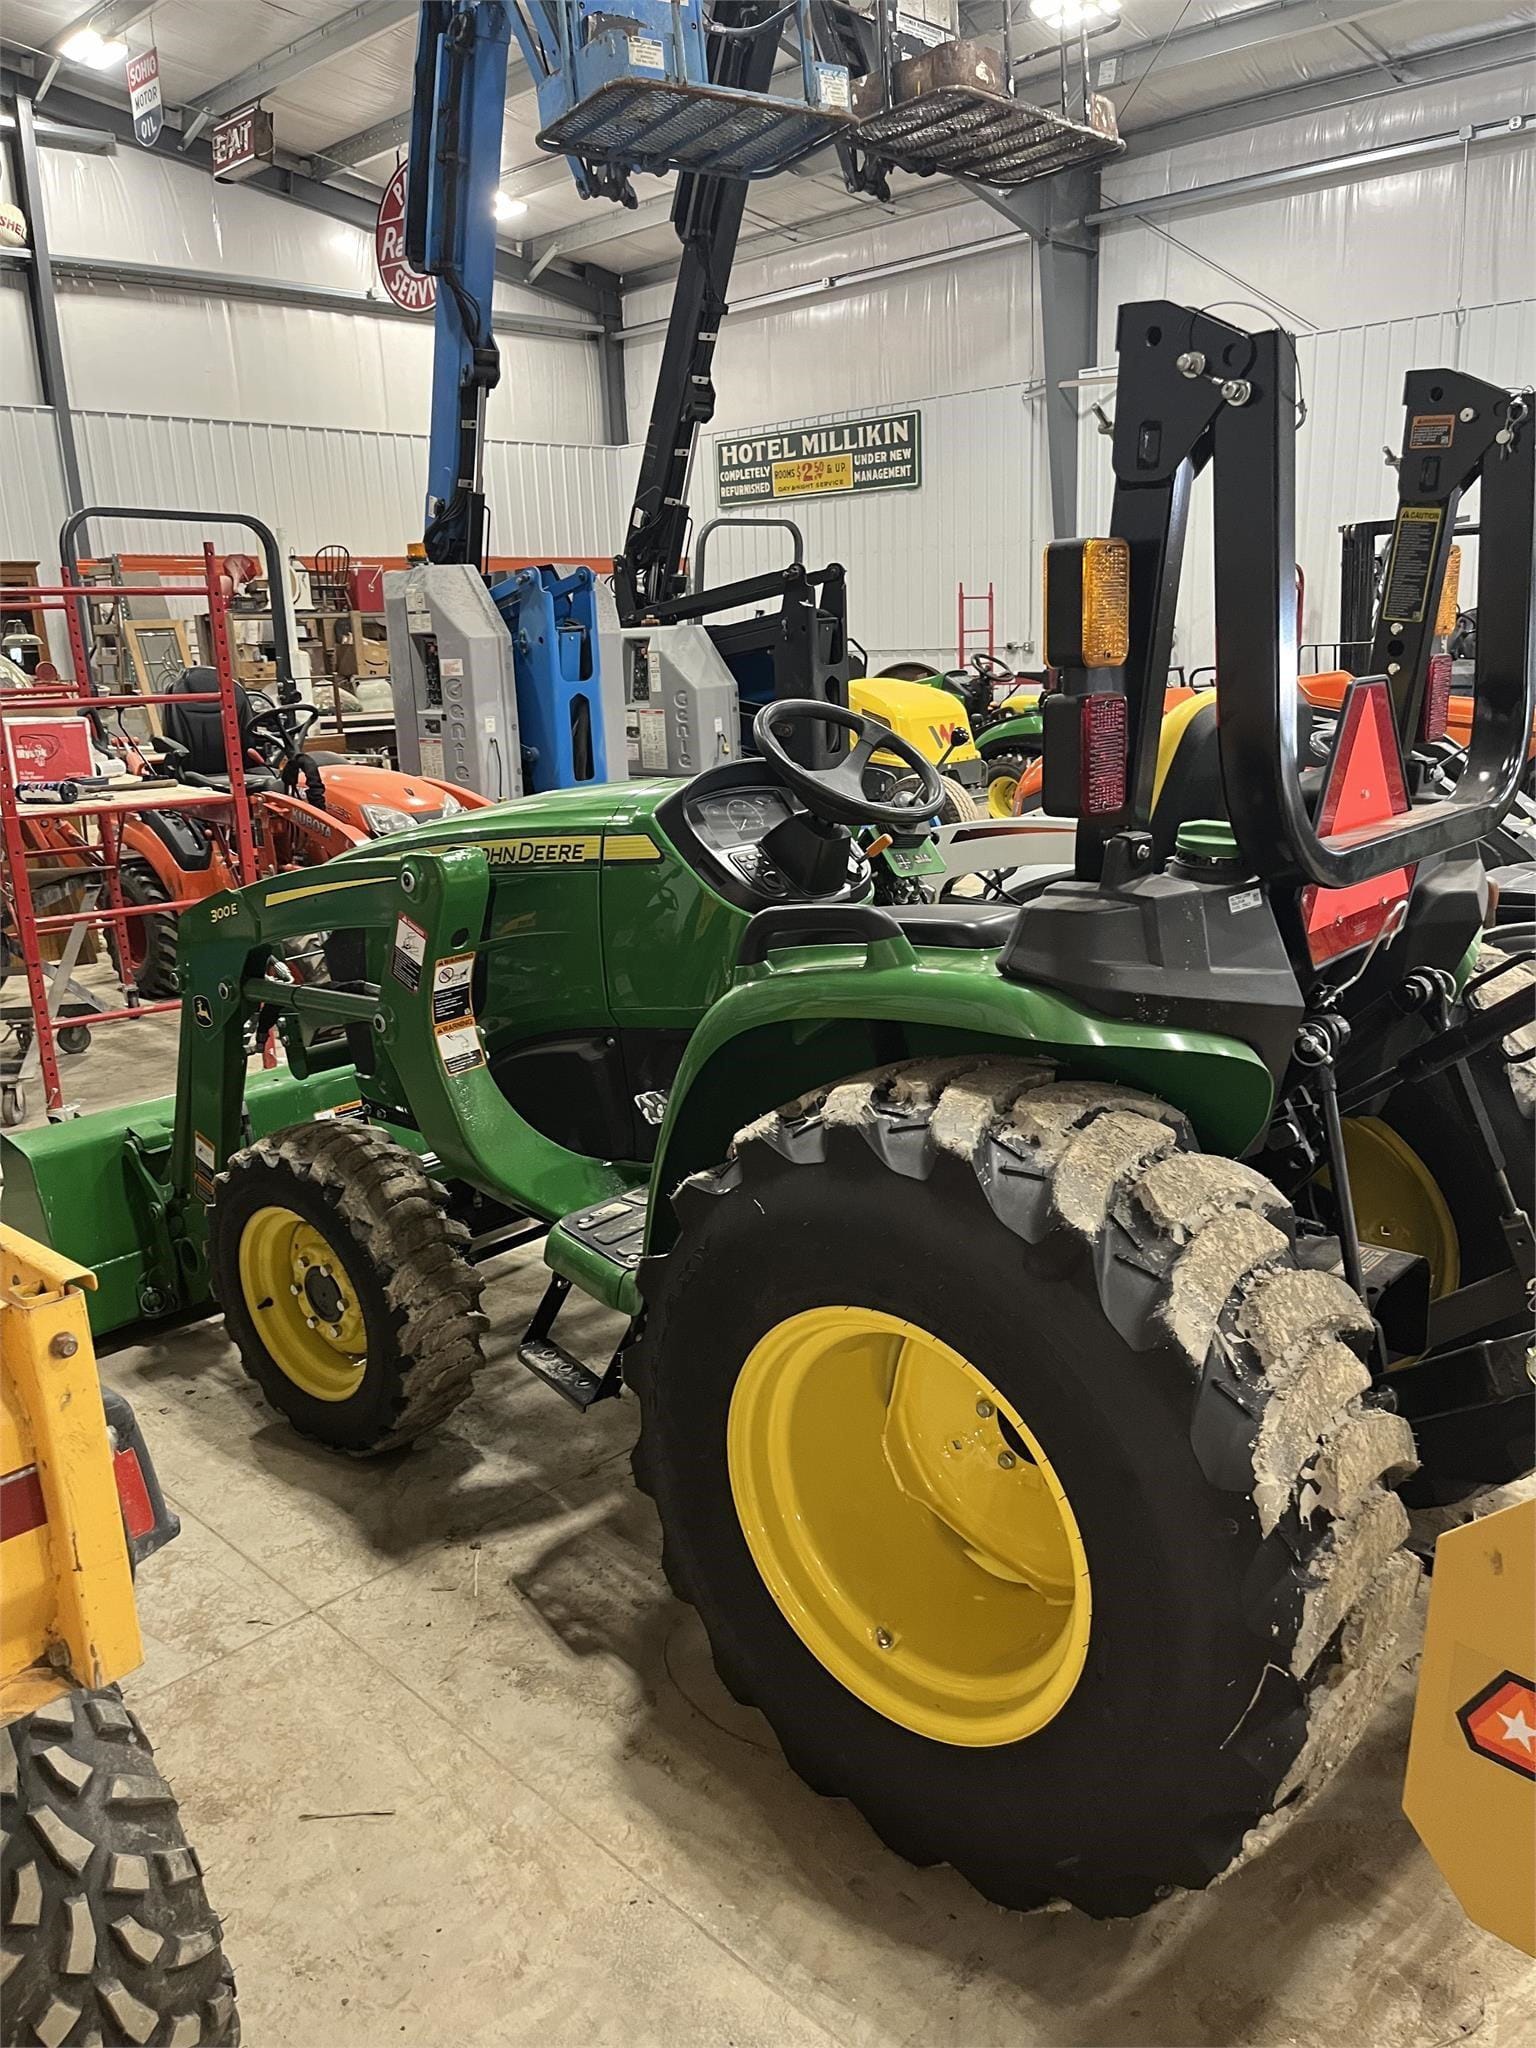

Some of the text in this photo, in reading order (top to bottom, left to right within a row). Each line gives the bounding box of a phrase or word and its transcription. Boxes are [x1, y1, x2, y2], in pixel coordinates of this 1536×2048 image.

[129, 55, 157, 87] SOHIO
[135, 86, 158, 110] MOTOR
[141, 116, 157, 139] OIL
[721, 420, 908, 466] HOTEL MILLIKIN
[854, 448, 911, 466] UNDER NEW
[720, 466, 770, 482] COMPLETELY
[775, 468, 795, 480] ROOMS
[854, 465, 912, 483] MANAGEMENT
[720, 482, 770, 498] REFURNISHED
[816, 479, 843, 488] SERVICE
[290, 807, 333, 838] KUBOTA
[518, 843, 585, 862] DEERE
[442, 1018, 474, 1032] WARNING
